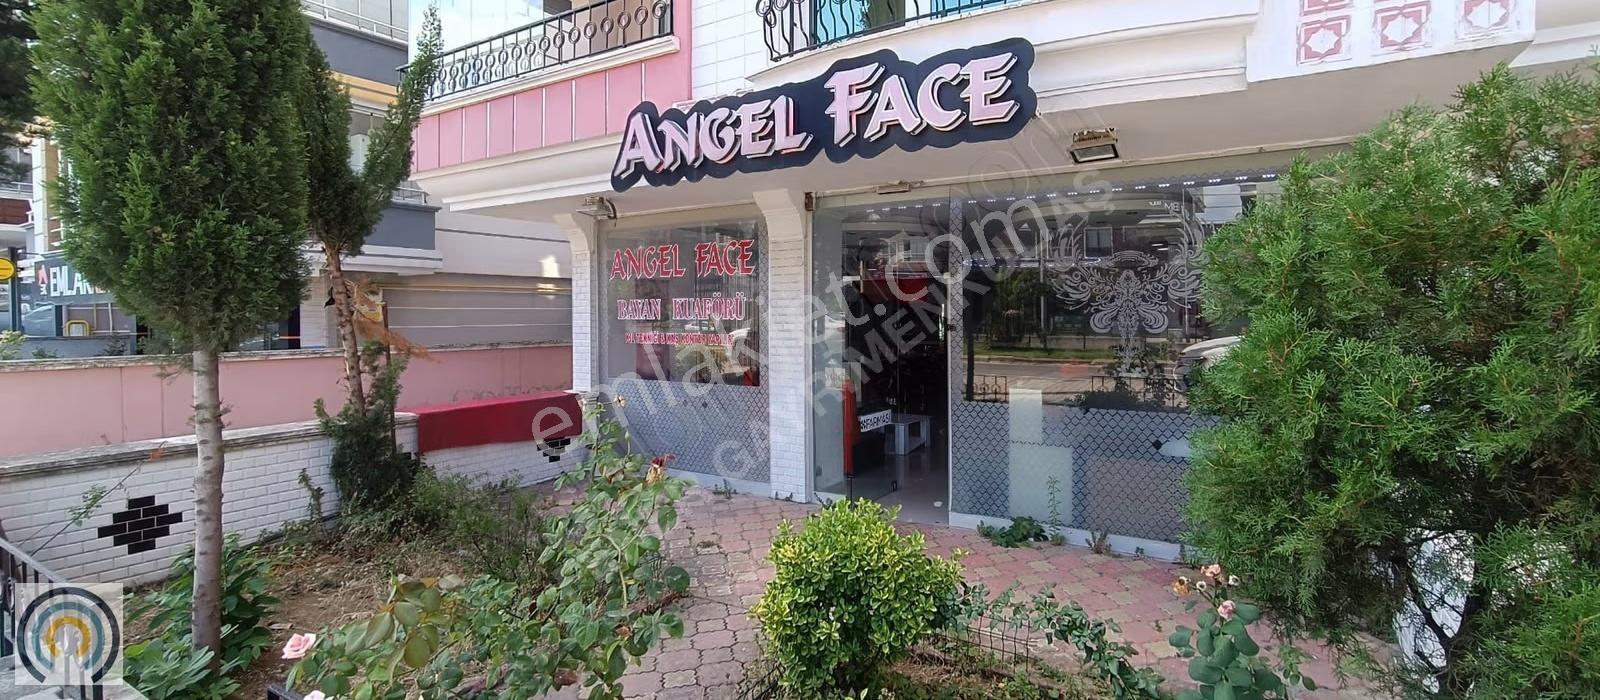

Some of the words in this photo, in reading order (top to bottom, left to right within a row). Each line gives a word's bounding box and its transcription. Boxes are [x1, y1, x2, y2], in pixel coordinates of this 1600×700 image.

[614, 94, 813, 179] ANGEL
[823, 52, 1020, 147] FACE
[608, 243, 687, 281] ANGEL
[694, 239, 756, 278] FACE
[616, 298, 662, 321] BAYAN
[672, 291, 747, 321] KUAFÖRÜ
